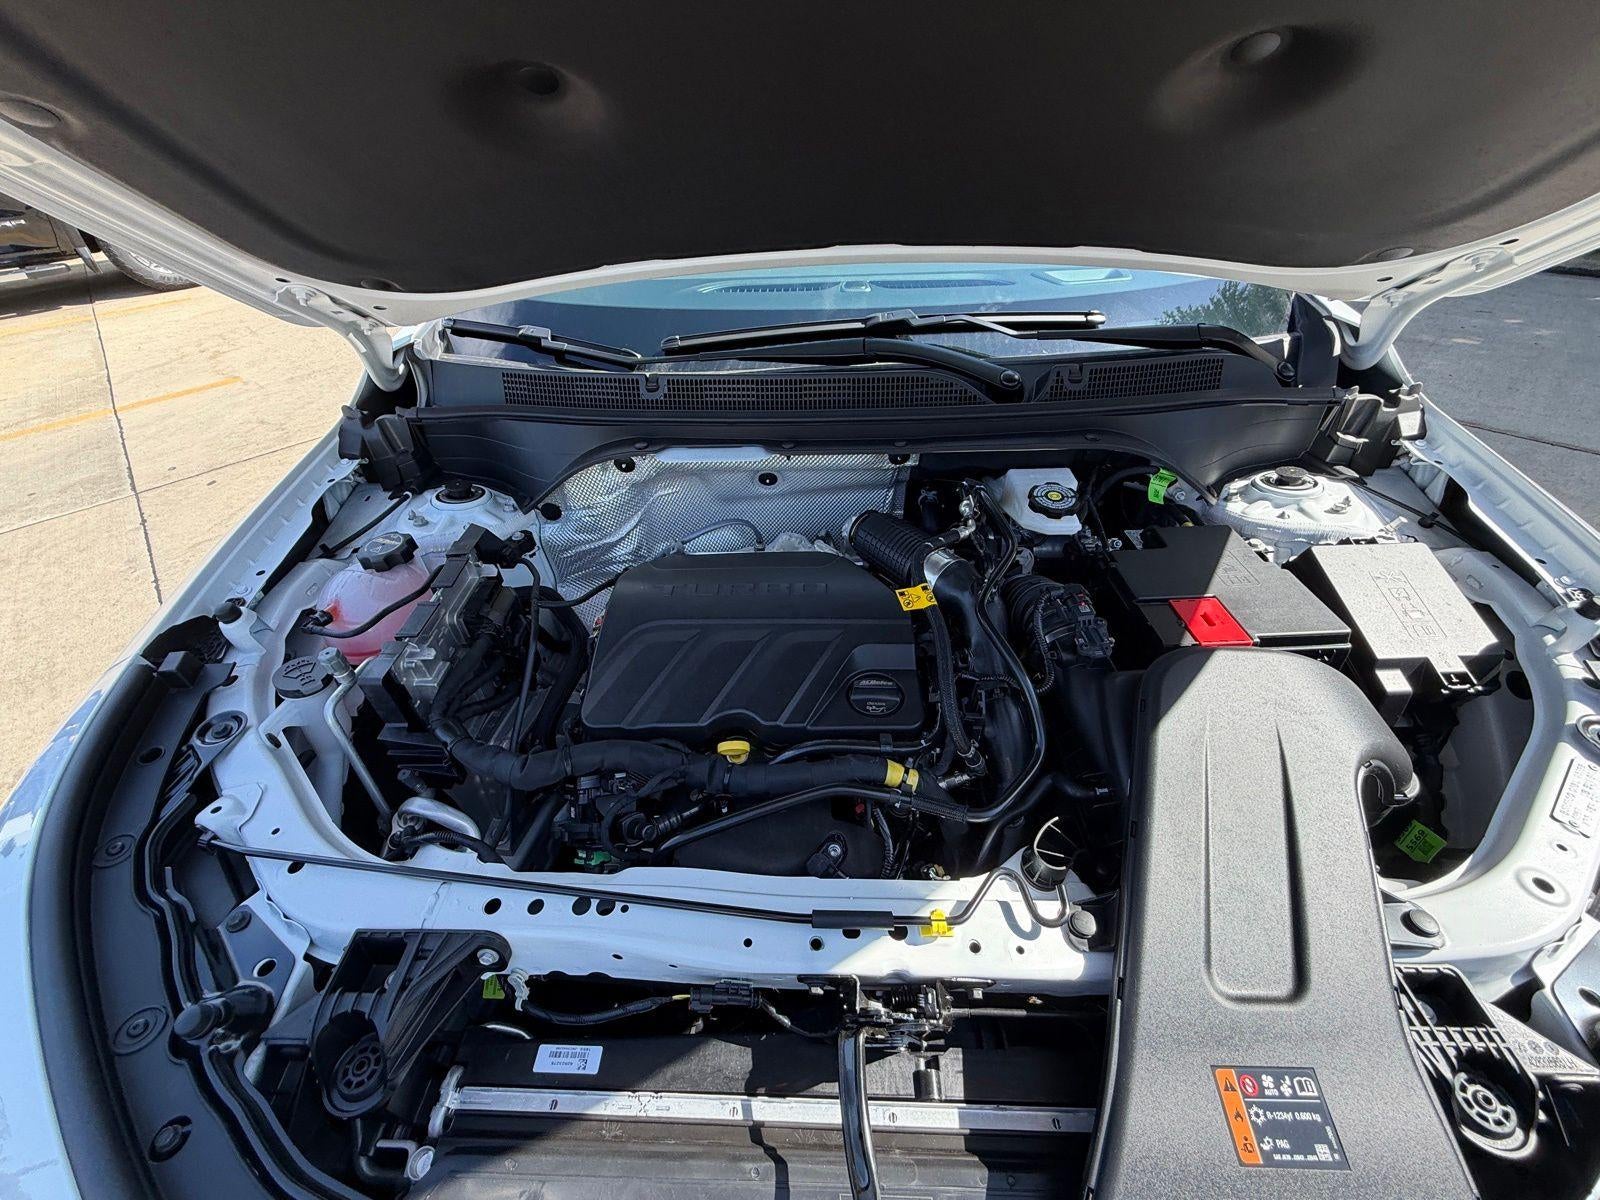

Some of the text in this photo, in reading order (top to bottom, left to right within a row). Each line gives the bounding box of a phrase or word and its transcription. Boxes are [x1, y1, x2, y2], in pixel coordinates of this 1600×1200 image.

[655, 582, 829, 598] TURBO
[1312, 1112, 1322, 1122] kg
[1276, 1139, 1291, 1149] PAG
